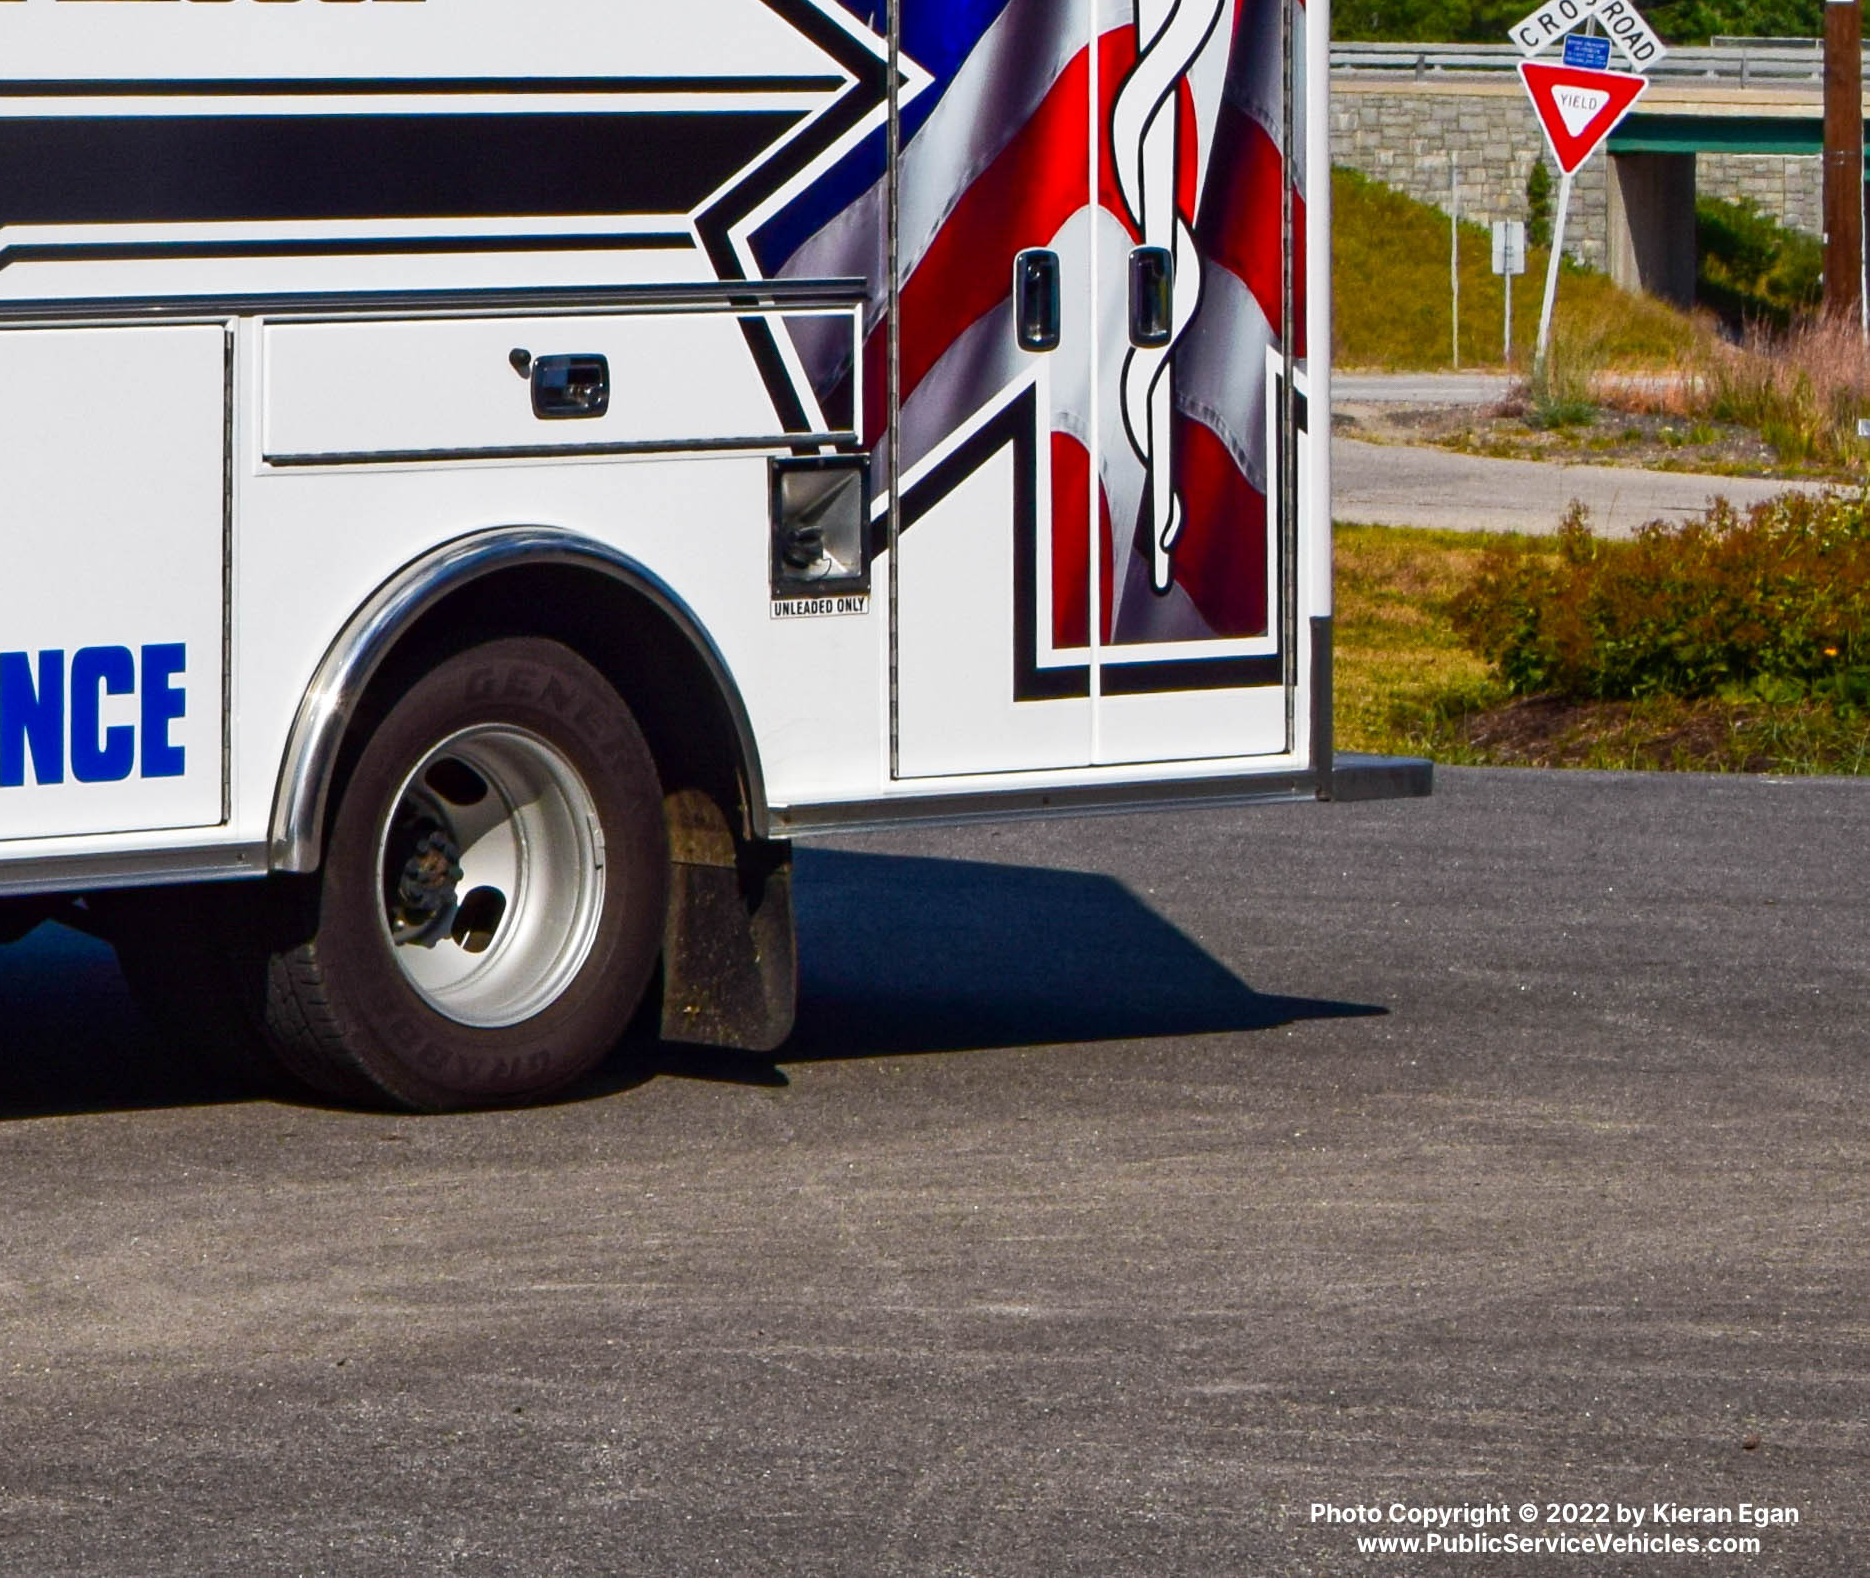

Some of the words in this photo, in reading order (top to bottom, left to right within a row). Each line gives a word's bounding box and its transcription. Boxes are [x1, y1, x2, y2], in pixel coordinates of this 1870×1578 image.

[1601, 1, 1656, 62] ROAD
[1560, 93, 1598, 111] YIELD
[774, 599, 833, 616] UNLEADED
[836, 596, 865, 613] ONLY
